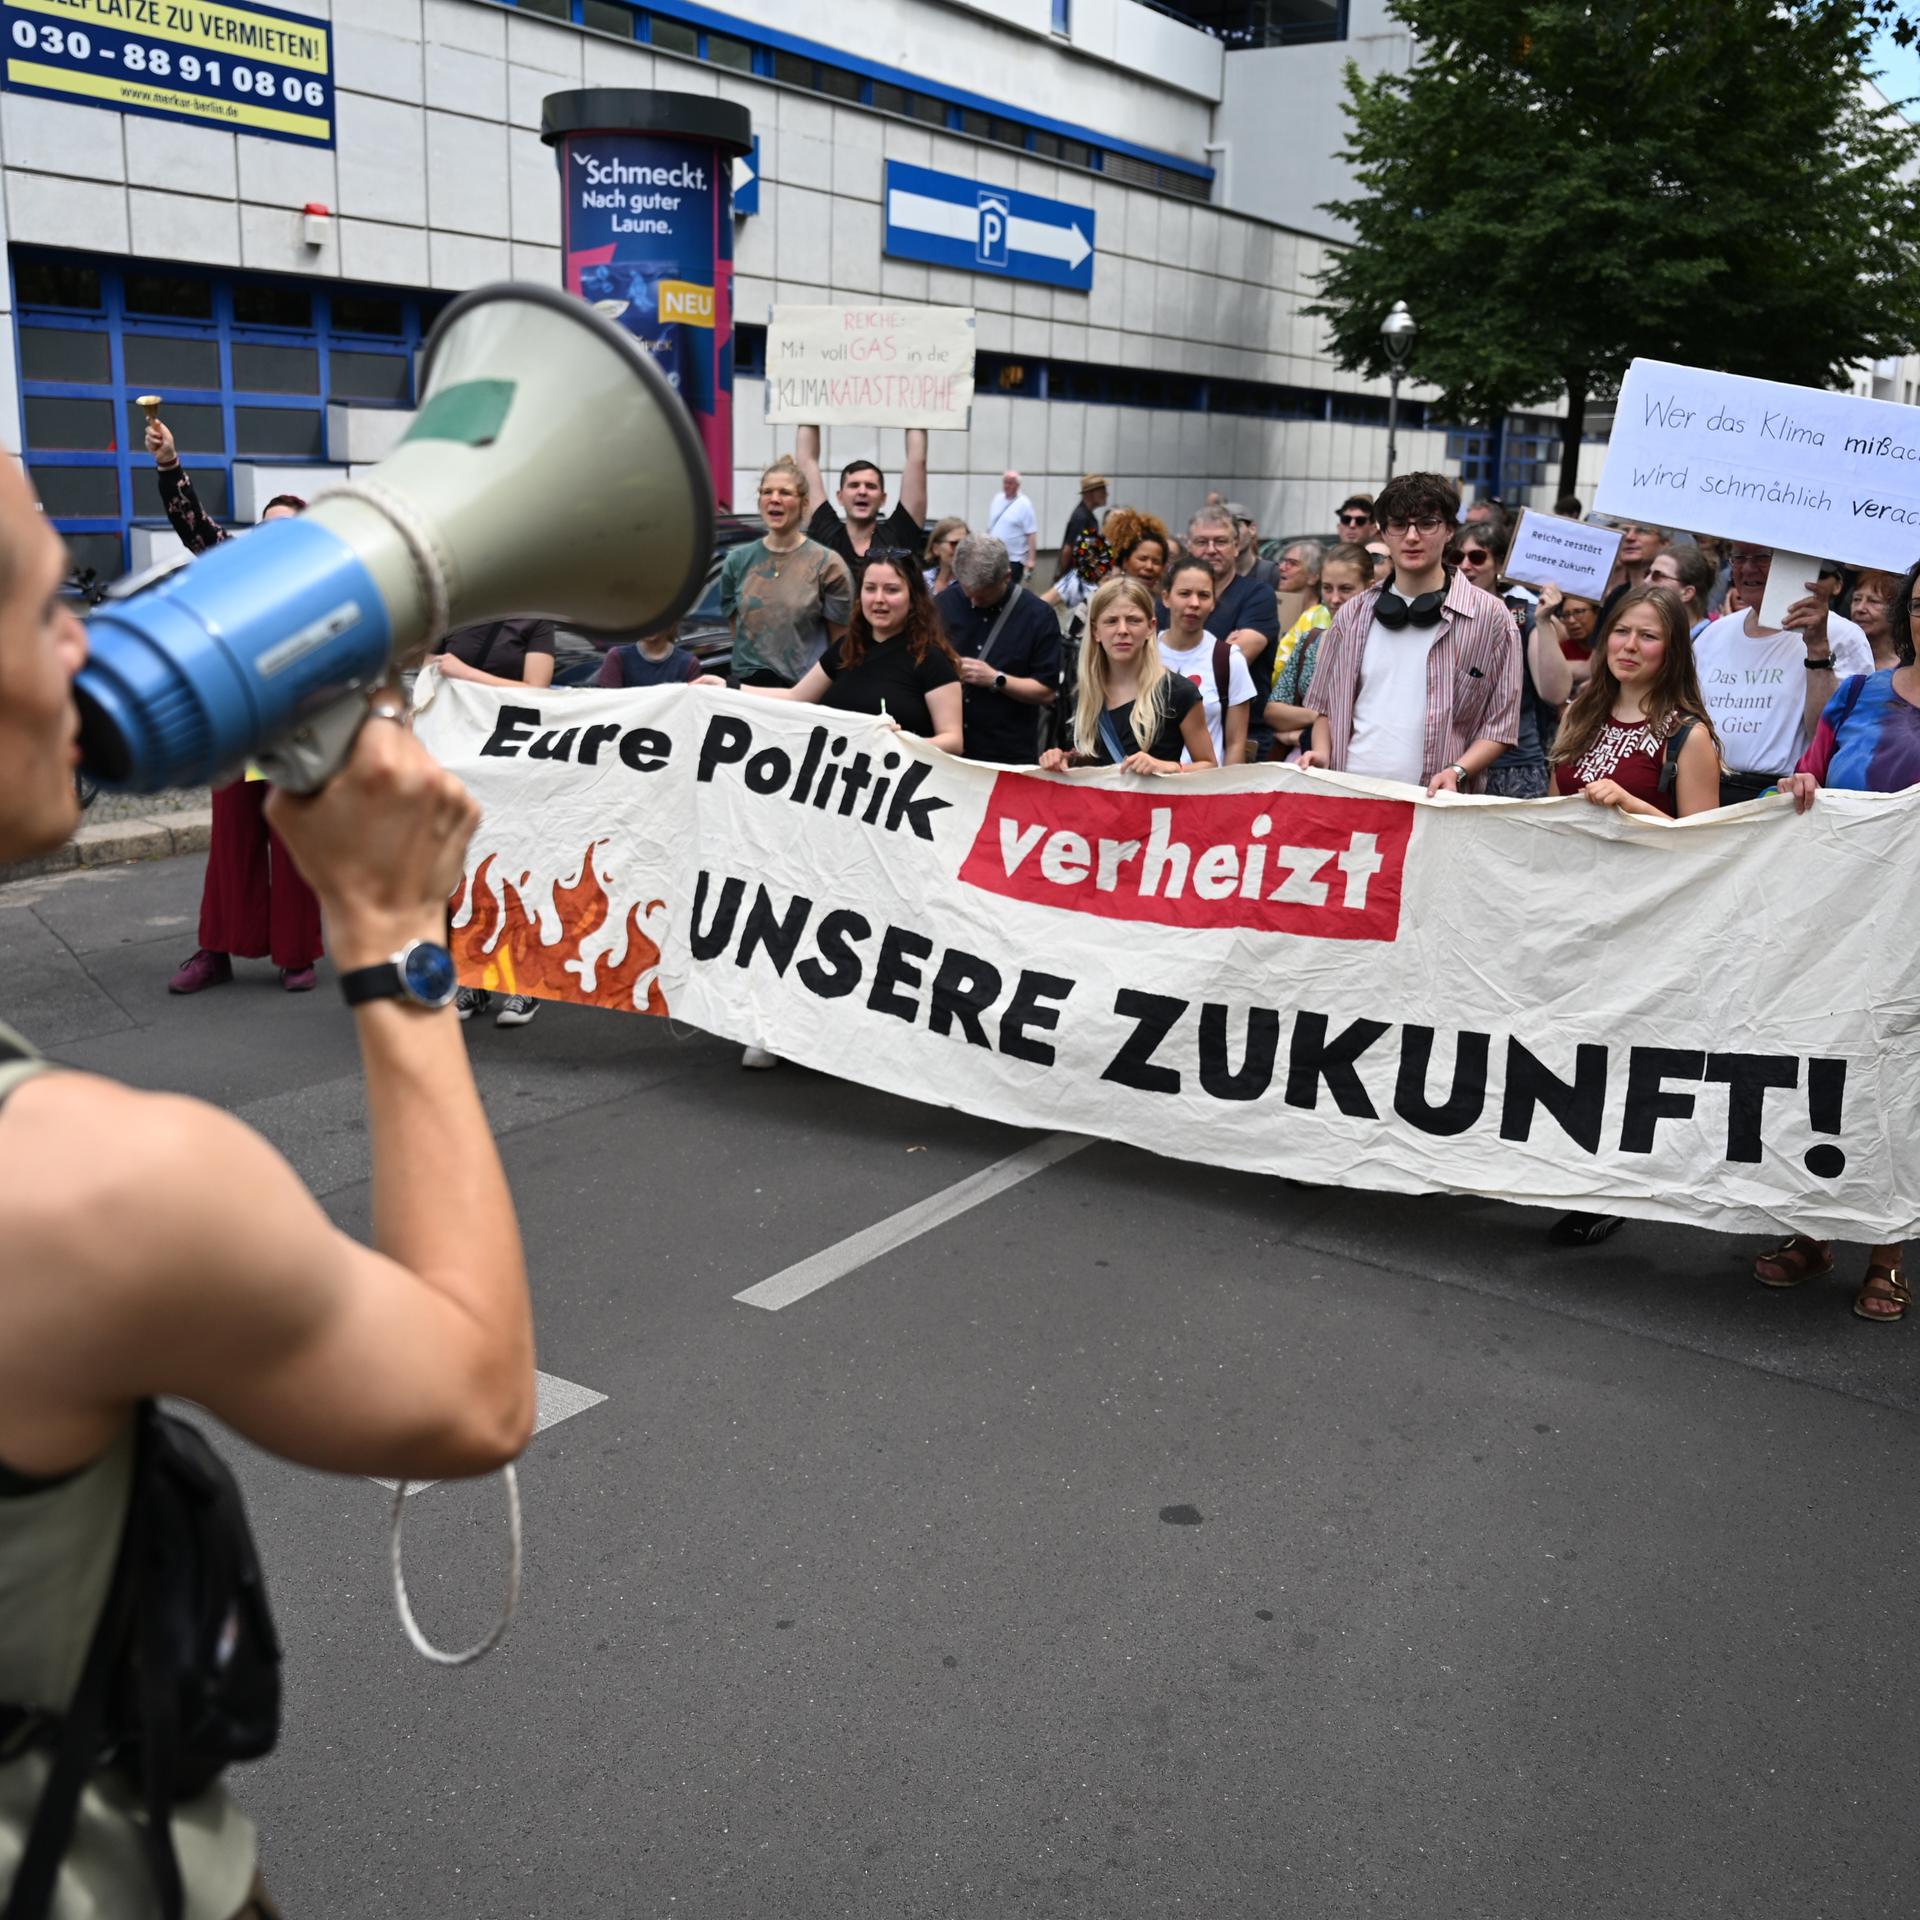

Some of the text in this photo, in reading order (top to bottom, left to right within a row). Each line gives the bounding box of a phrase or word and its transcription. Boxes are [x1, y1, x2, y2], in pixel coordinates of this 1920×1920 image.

[167, 5, 193, 32] ZU
[199, 14, 319, 61] VERMIETEN!
[12, 20, 91, 59] 030
[123, 43, 171, 76] 88
[178, 55, 222, 86] 91
[232, 66, 276, 97] 08
[282, 76, 325, 107] 06
[582, 189, 681, 214] Nach guter
[611, 213, 673, 235] Laune.
[665, 291, 714, 316] NEU
[843, 311, 906, 331] REICHE:
[780, 341, 805, 359] Mit
[907, 344, 922, 362] in
[927, 343, 950, 363] die
[777, 374, 962, 413] KLIMAKATASTROPHE
[1644, 392, 1920, 462] Wer das Klima mißac
[1852, 499, 1920, 526] verac
[1531, 530, 1603, 556] Reiche zerstört
[1525, 552, 1597, 576] unsere Zukunft
[1708, 668, 1784, 685] Das WIR
[1721, 716, 1763, 734] Gier
[479, 705, 1384, 910] Eure Politik verheizt
[689, 869, 1848, 1179] UNSERE ZUKUNFT!
